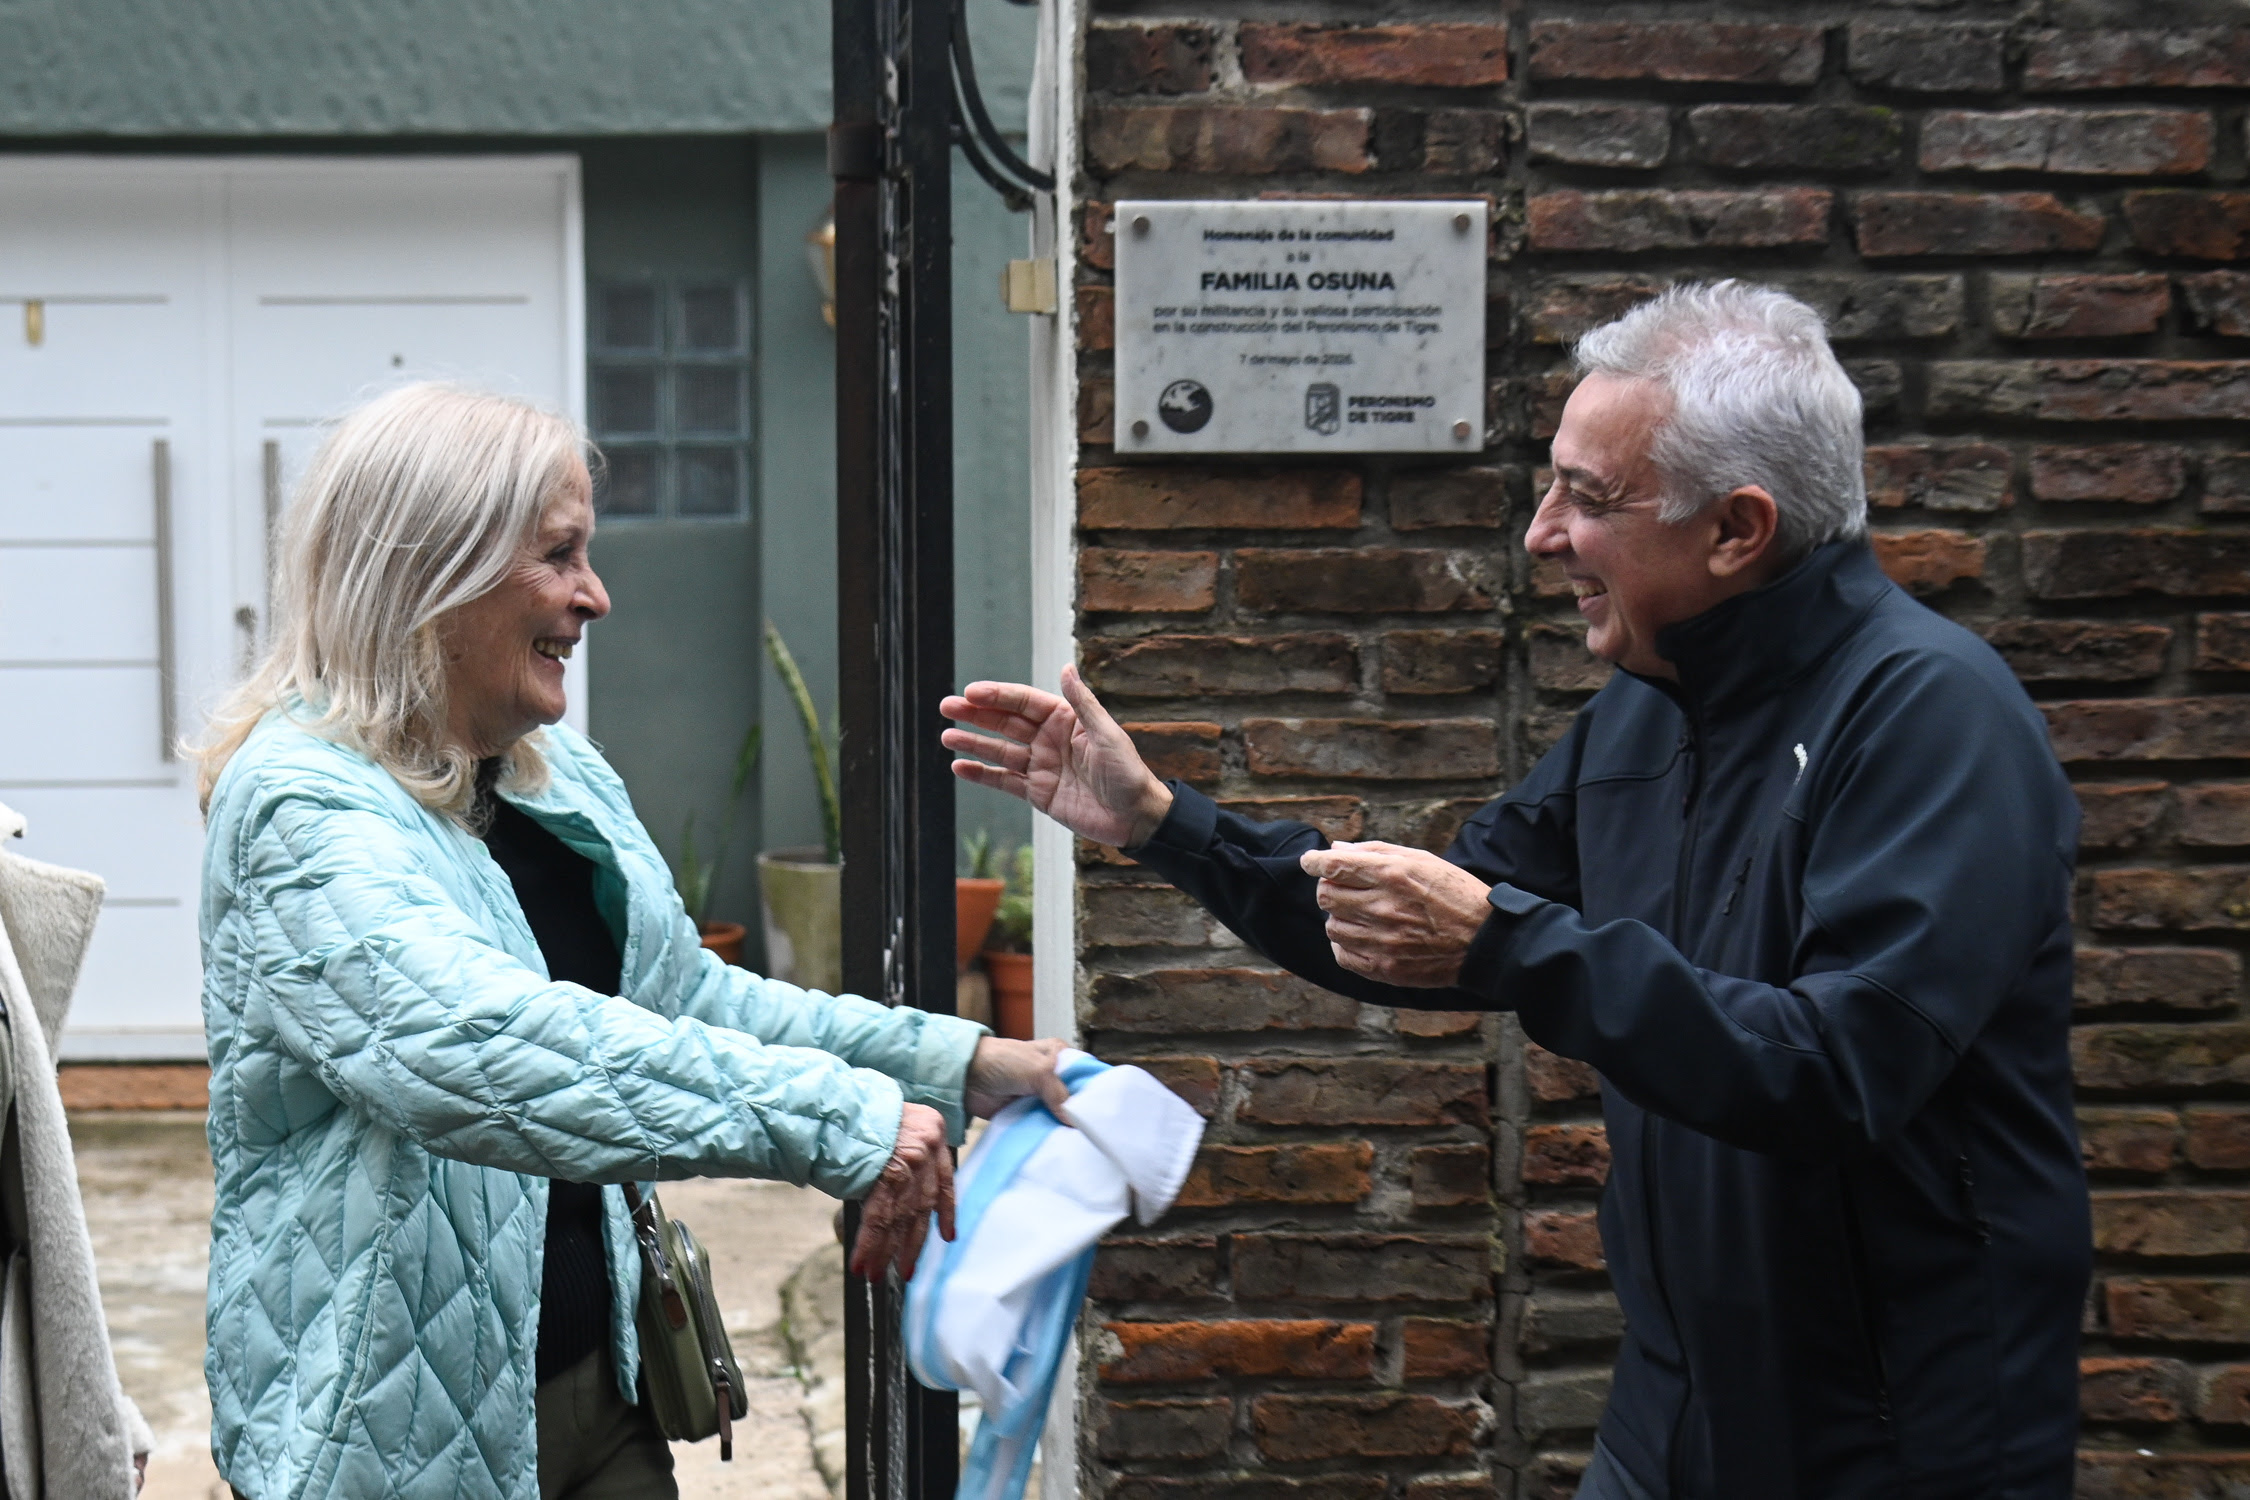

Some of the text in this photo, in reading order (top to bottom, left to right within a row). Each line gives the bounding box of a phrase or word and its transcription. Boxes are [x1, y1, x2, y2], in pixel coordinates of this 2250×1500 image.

[1203, 229, 1395, 243] Homenaje de la comunidad
[1286, 250, 1311, 263] a la
[1201, 272, 1395, 291] FAMILIA OSUNA
[1153, 304, 1442, 319] por su militancia y su valiosa participación
[1153, 322, 1170, 333] en
[1174, 321, 1186, 333] la
[1189, 321, 1277, 333] construcción
[1281, 321, 1303, 333] del
[1306, 321, 1380, 333] Peronismo
[1382, 321, 1401, 333] de
[1249, 354, 1265, 365] de
[1266, 355, 1301, 367] mayo
[1303, 354, 1319, 365] de
[1348, 395, 1436, 408] PERONISMO
[1348, 411, 1415, 423] DE TIGRE
